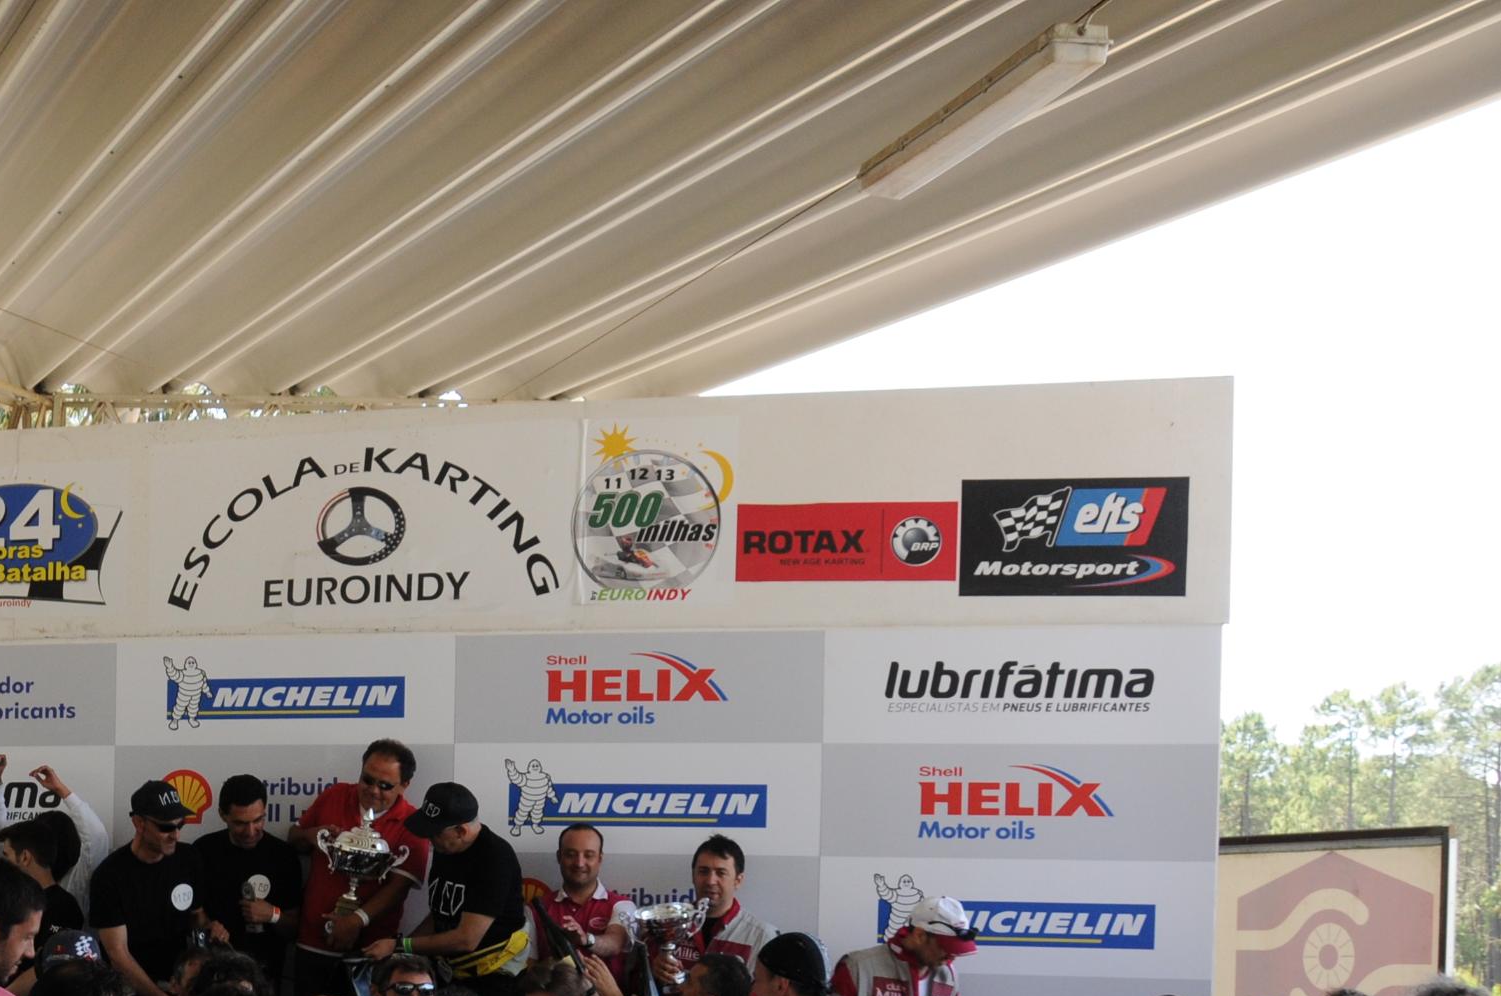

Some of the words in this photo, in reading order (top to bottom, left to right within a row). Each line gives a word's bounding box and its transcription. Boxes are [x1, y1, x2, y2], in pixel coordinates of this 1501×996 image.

[630, 468, 649, 480] 12
[655, 470, 675, 481] 13
[588, 490, 664, 528] 500
[167, 456, 327, 611] ESCOLA
[333, 462, 360, 476] DE
[363, 447, 561, 597] KARTING
[636, 520, 717, 542] milhas
[743, 529, 865, 554] ROTAX
[910, 542, 940, 552] BRP
[824, 558, 865, 566] KARTING
[974, 560, 1138, 579] Motorsport
[263, 571, 470, 608] EUROINDY
[597, 587, 691, 601] EUROINDY
[546, 655, 587, 665] Shell
[546, 668, 722, 702] HELIX
[885, 661, 1154, 699] lubrifátima
[212, 685, 397, 708] MICHELIN
[546, 706, 612, 725] Motor
[617, 705, 655, 725] oils
[887, 702, 979, 713] ESPECIALISTAS
[982, 702, 1000, 712] EM
[1002, 702, 1042, 712] PNEUS
[1045, 702, 1053, 712] E
[1055, 702, 1151, 713] LUBRIFICANTES
[919, 766, 962, 777] Shell
[558, 792, 759, 815] MICHELIN
[918, 782, 1107, 816] HELIX
[918, 821, 990, 839] Motor
[995, 820, 1035, 839] oils
